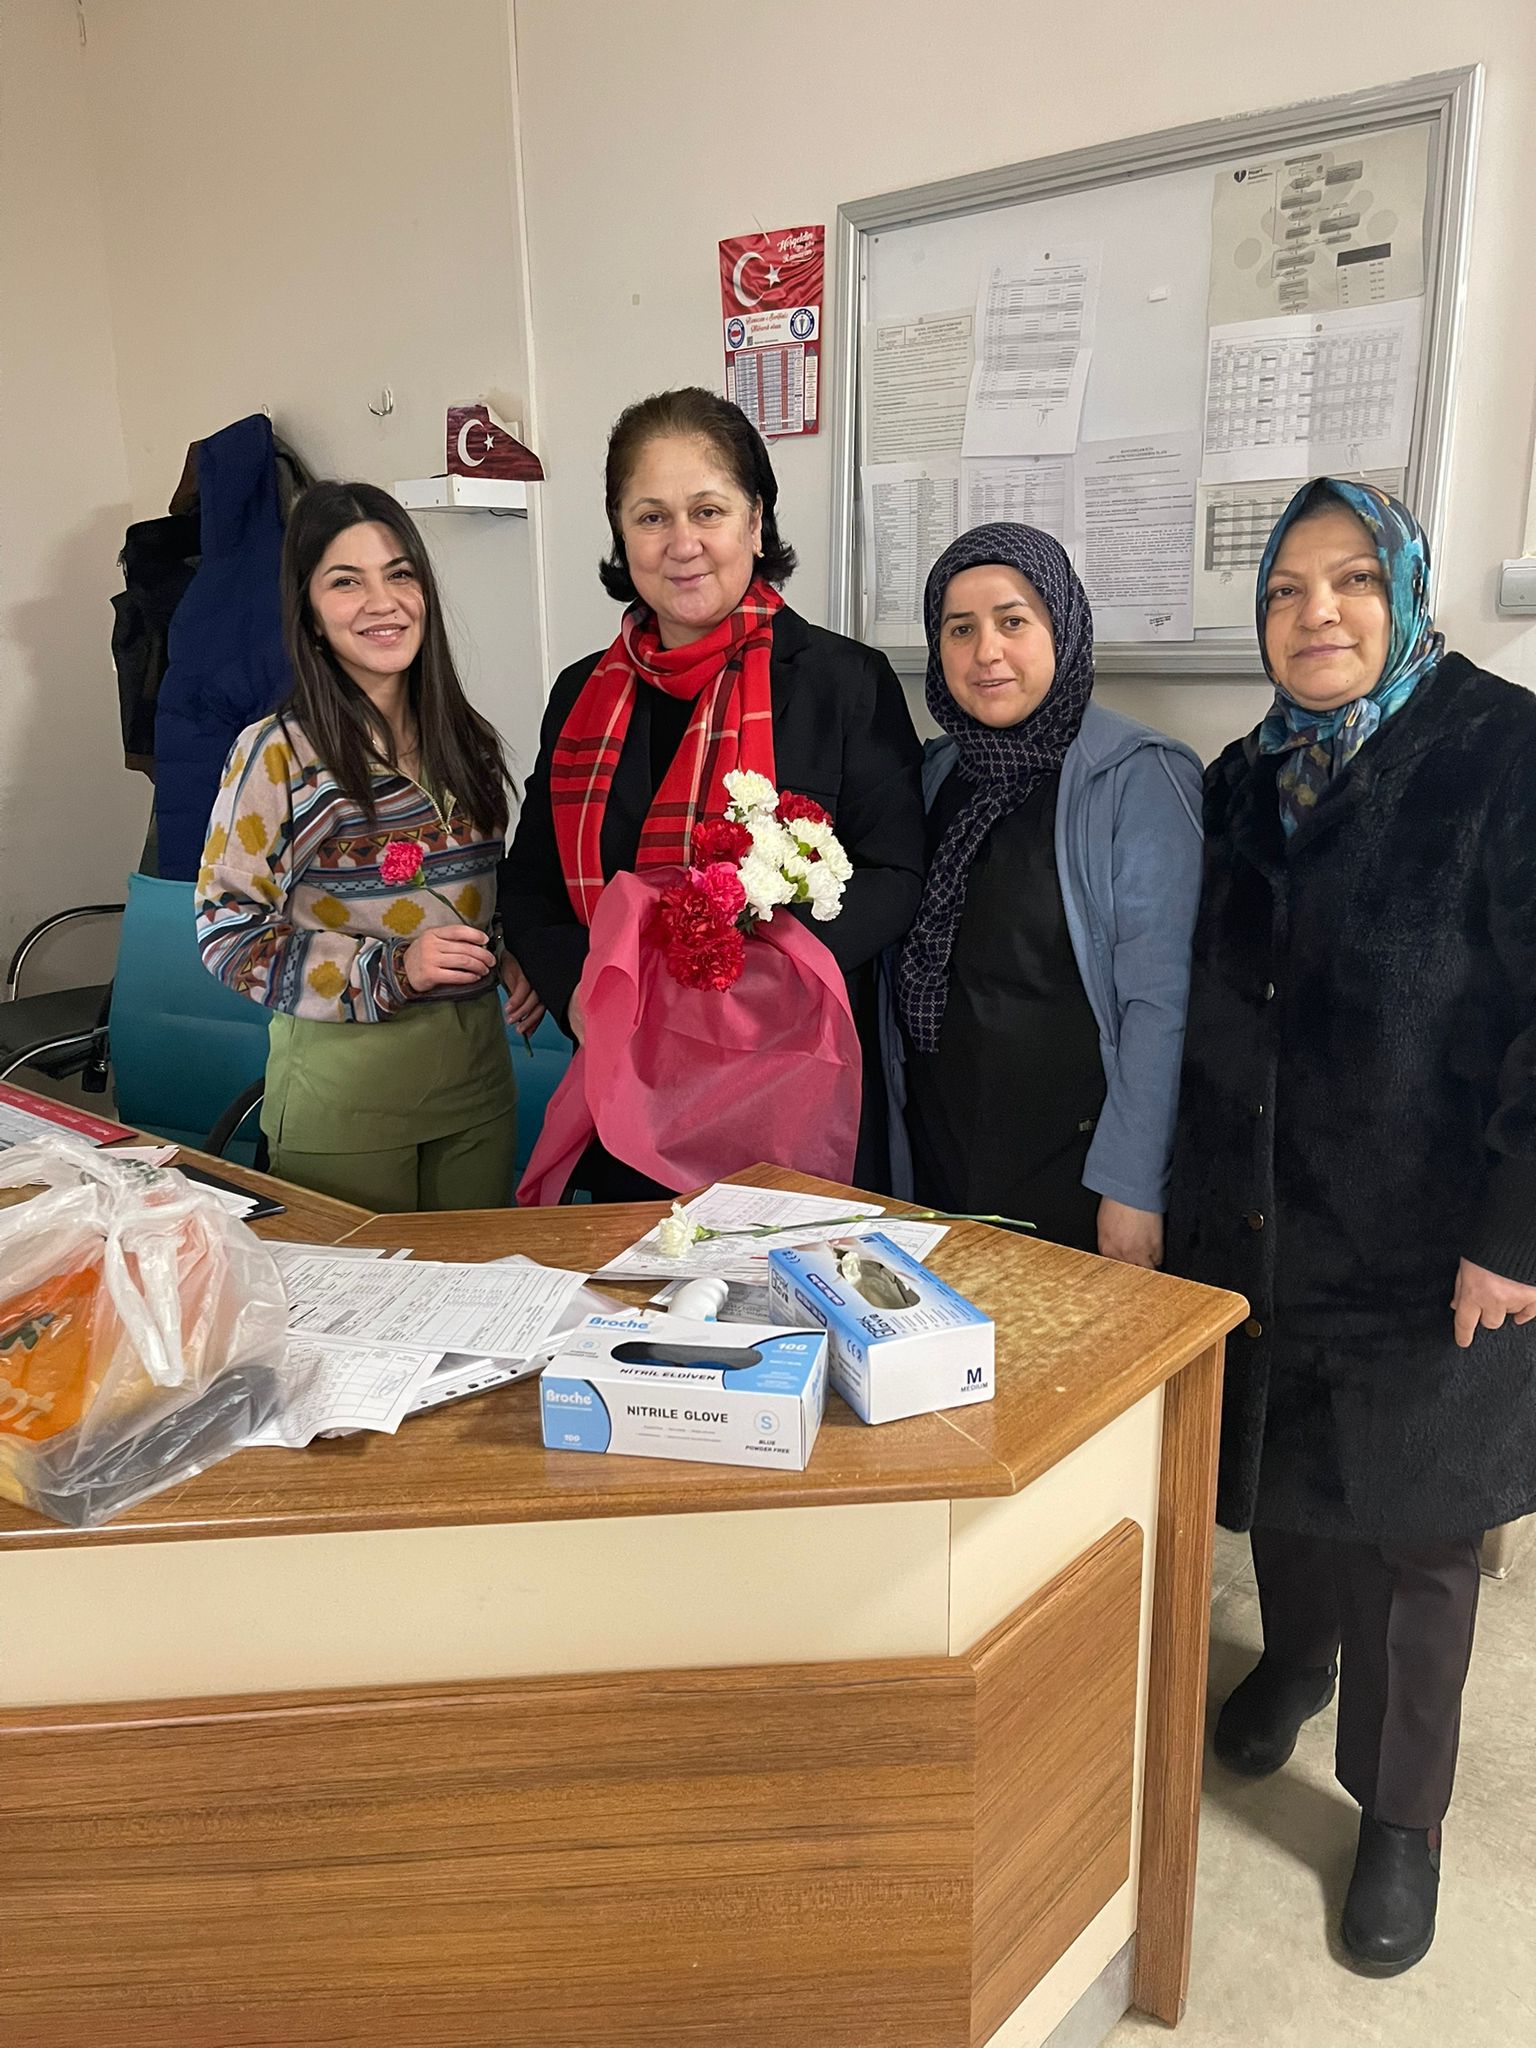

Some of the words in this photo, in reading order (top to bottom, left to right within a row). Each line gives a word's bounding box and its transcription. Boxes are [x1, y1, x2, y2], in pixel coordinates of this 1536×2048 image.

[589, 1316, 650, 1330] Broche
[777, 1342, 808, 1351] 100
[966, 1367, 983, 1385] M
[960, 1382, 989, 1393] MEDIUM
[546, 1388, 593, 1406] Broche
[626, 1405, 679, 1420] NITRILE
[684, 1410, 729, 1424] GLOVE
[760, 1415, 773, 1430] S
[564, 1433, 581, 1443] 100
